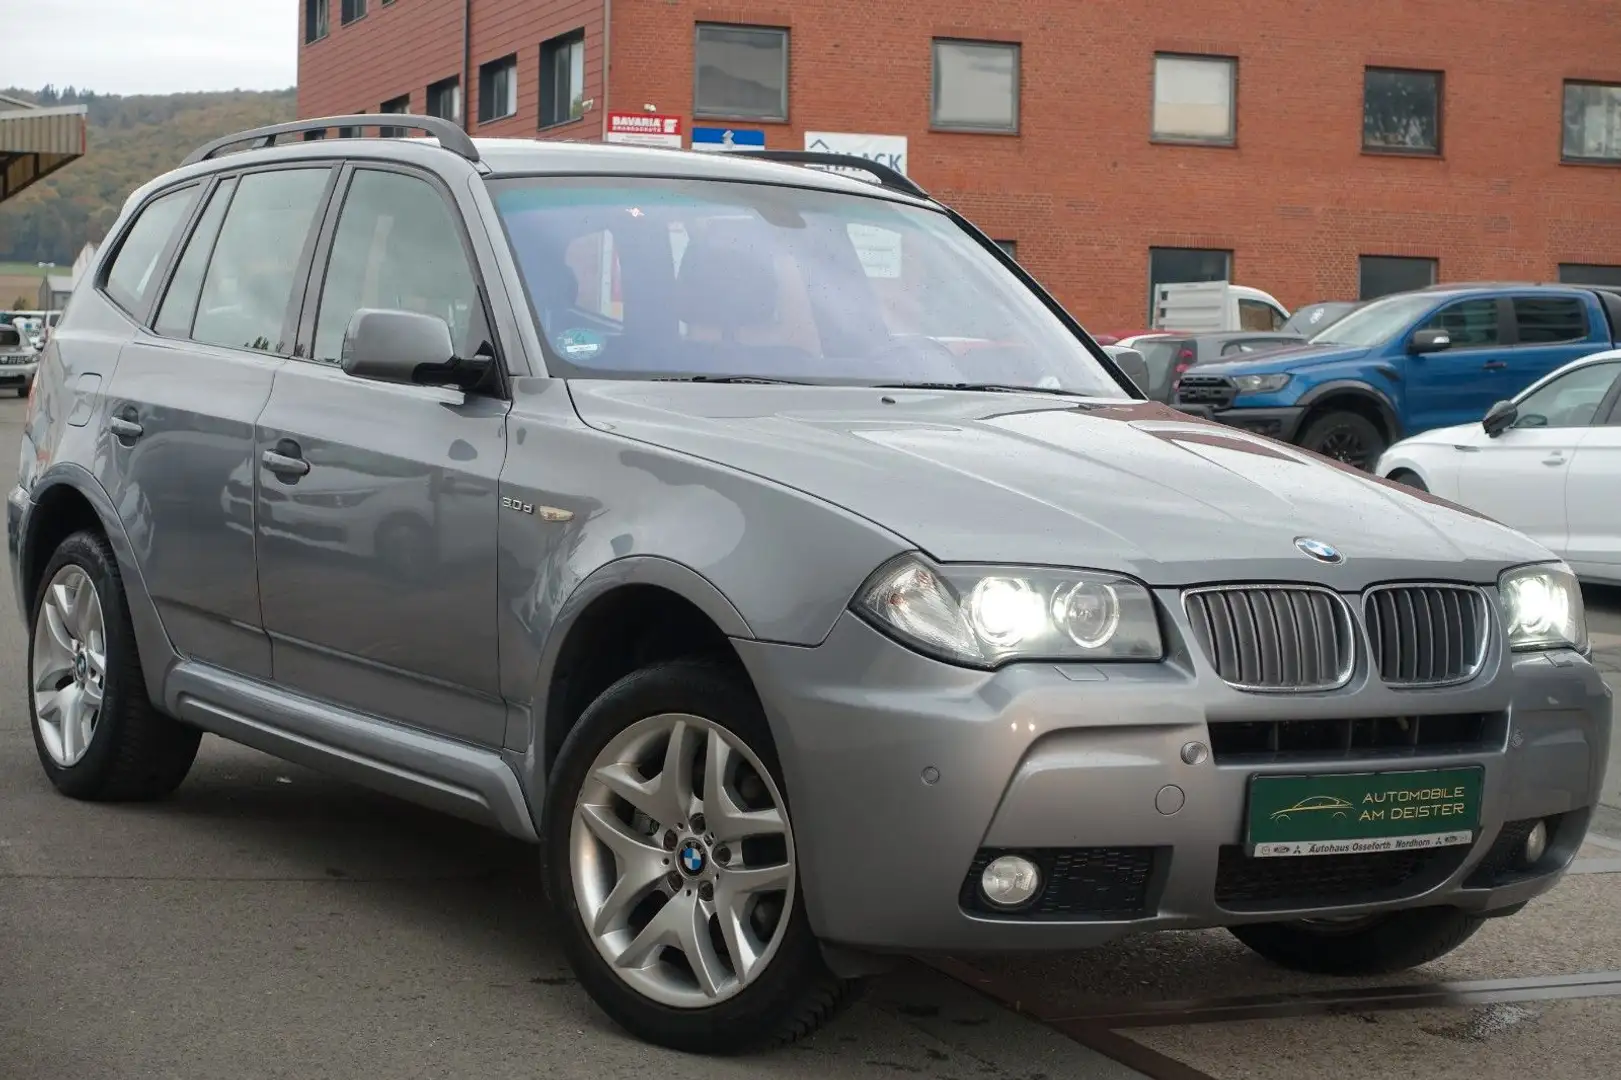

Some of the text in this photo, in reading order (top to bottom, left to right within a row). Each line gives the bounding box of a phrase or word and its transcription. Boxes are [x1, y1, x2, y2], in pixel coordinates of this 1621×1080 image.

[612, 115, 661, 127] BAVARIA
[1362, 786, 1465, 804] AUTOMOBILE
[1359, 802, 1465, 821] AM DEISTER
[1308, 842, 1350, 853] Autohaus
[1395, 838, 1431, 849] Nordhorn
